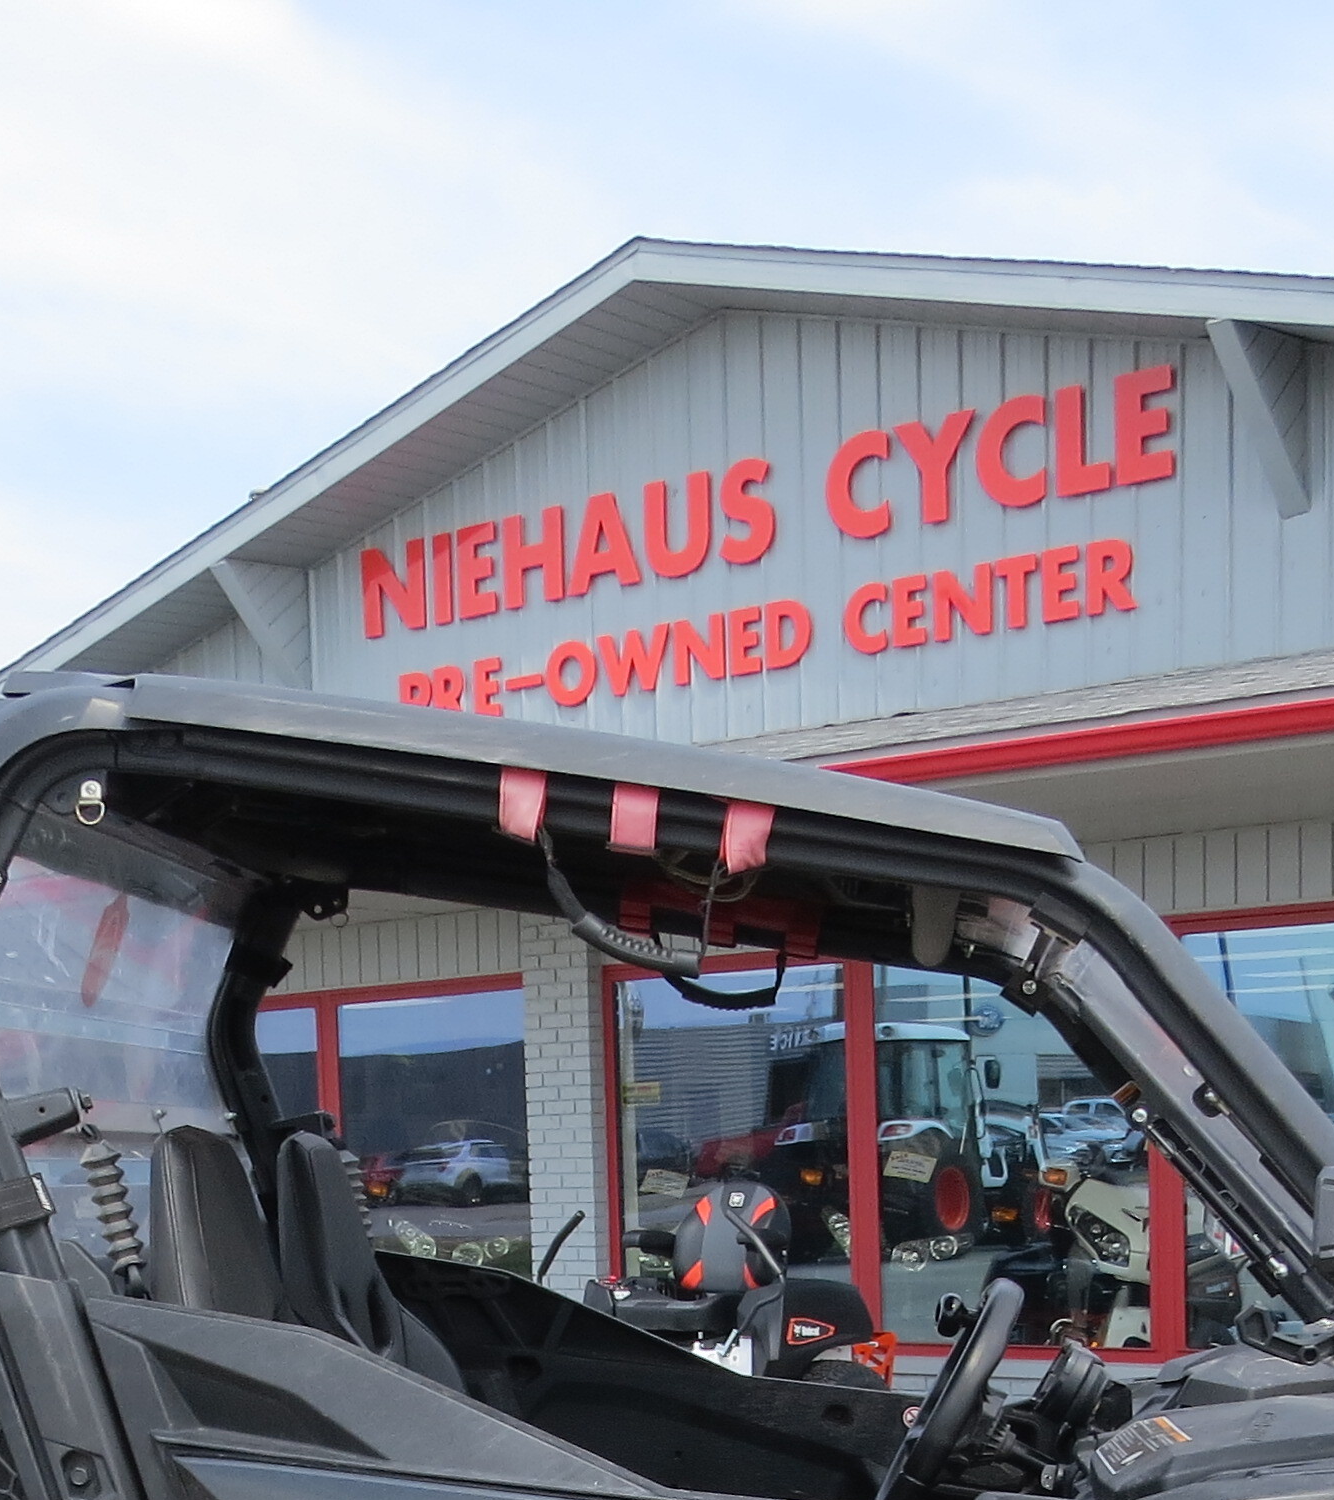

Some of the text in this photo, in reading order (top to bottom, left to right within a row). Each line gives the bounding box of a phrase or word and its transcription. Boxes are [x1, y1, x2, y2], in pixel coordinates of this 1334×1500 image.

[360, 363, 1176, 639] NIEHAUS CYCLE
[398, 538, 1138, 717] PRE-OWNED CENTER
